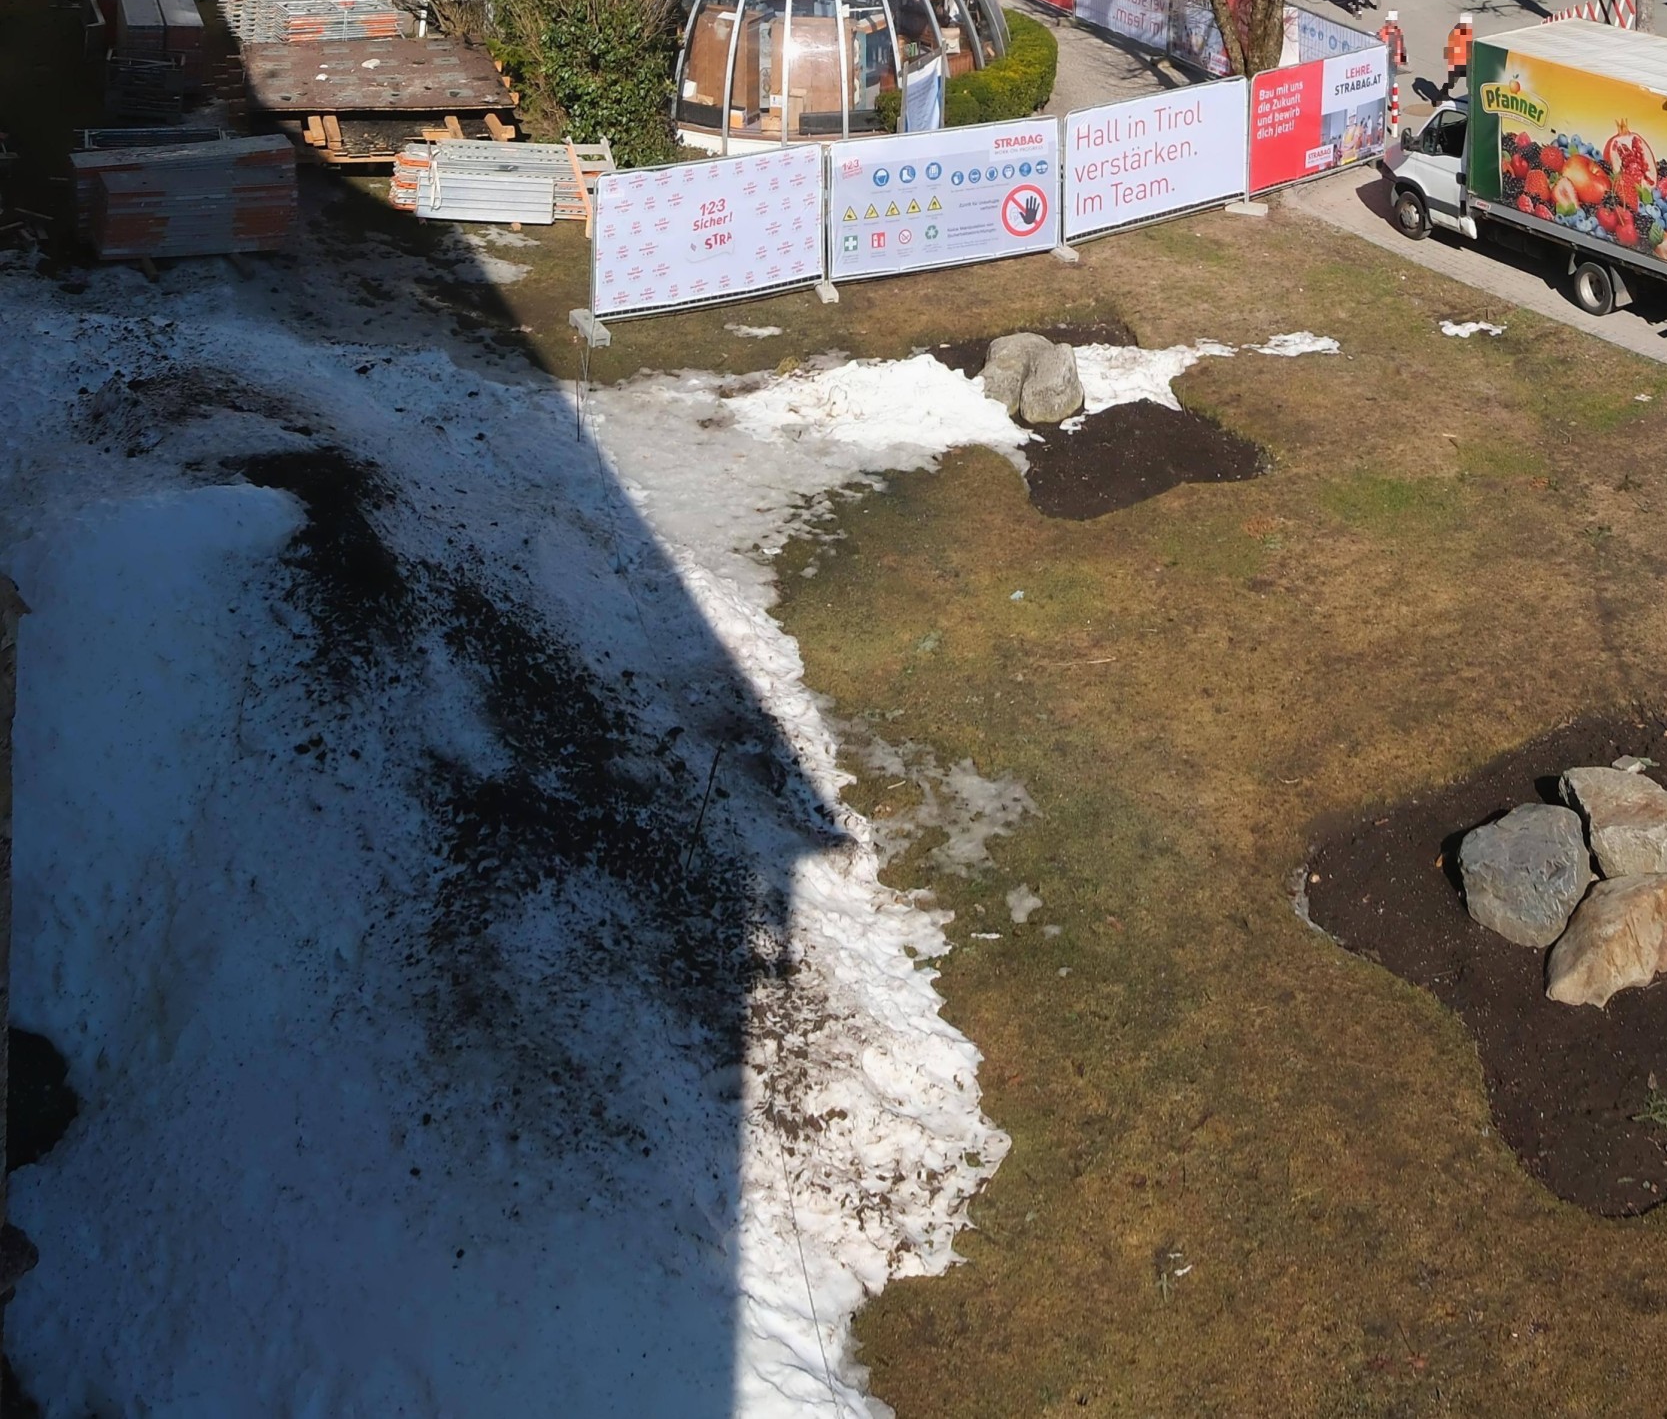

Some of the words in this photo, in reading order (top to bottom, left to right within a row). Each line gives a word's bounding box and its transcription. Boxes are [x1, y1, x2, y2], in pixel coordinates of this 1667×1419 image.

[1345, 63, 1373, 79] LEHRE.
[1259, 88, 1275, 99] Bau
[1275, 84, 1291, 95] mit
[1291, 81, 1304, 92] uns
[1334, 73, 1382, 96] STRABAG.AT
[1257, 101, 1271, 113] die
[1271, 95, 1301, 111] Zukunft
[1076, 117, 1120, 151] Hall
[1127, 114, 1147, 140] in
[1153, 100, 1203, 128] Tirol
[1256, 115, 1273, 127] und
[1273, 106, 1301, 124] bewirb
[994, 134, 1044, 149] STRABAG
[1256, 128, 1273, 140] dich
[1074, 140, 1198, 183] verstärken.
[1075, 192, 1104, 217] Im
[1110, 176, 1176, 209] Team.
[692, 212, 733, 232] Sicher!
